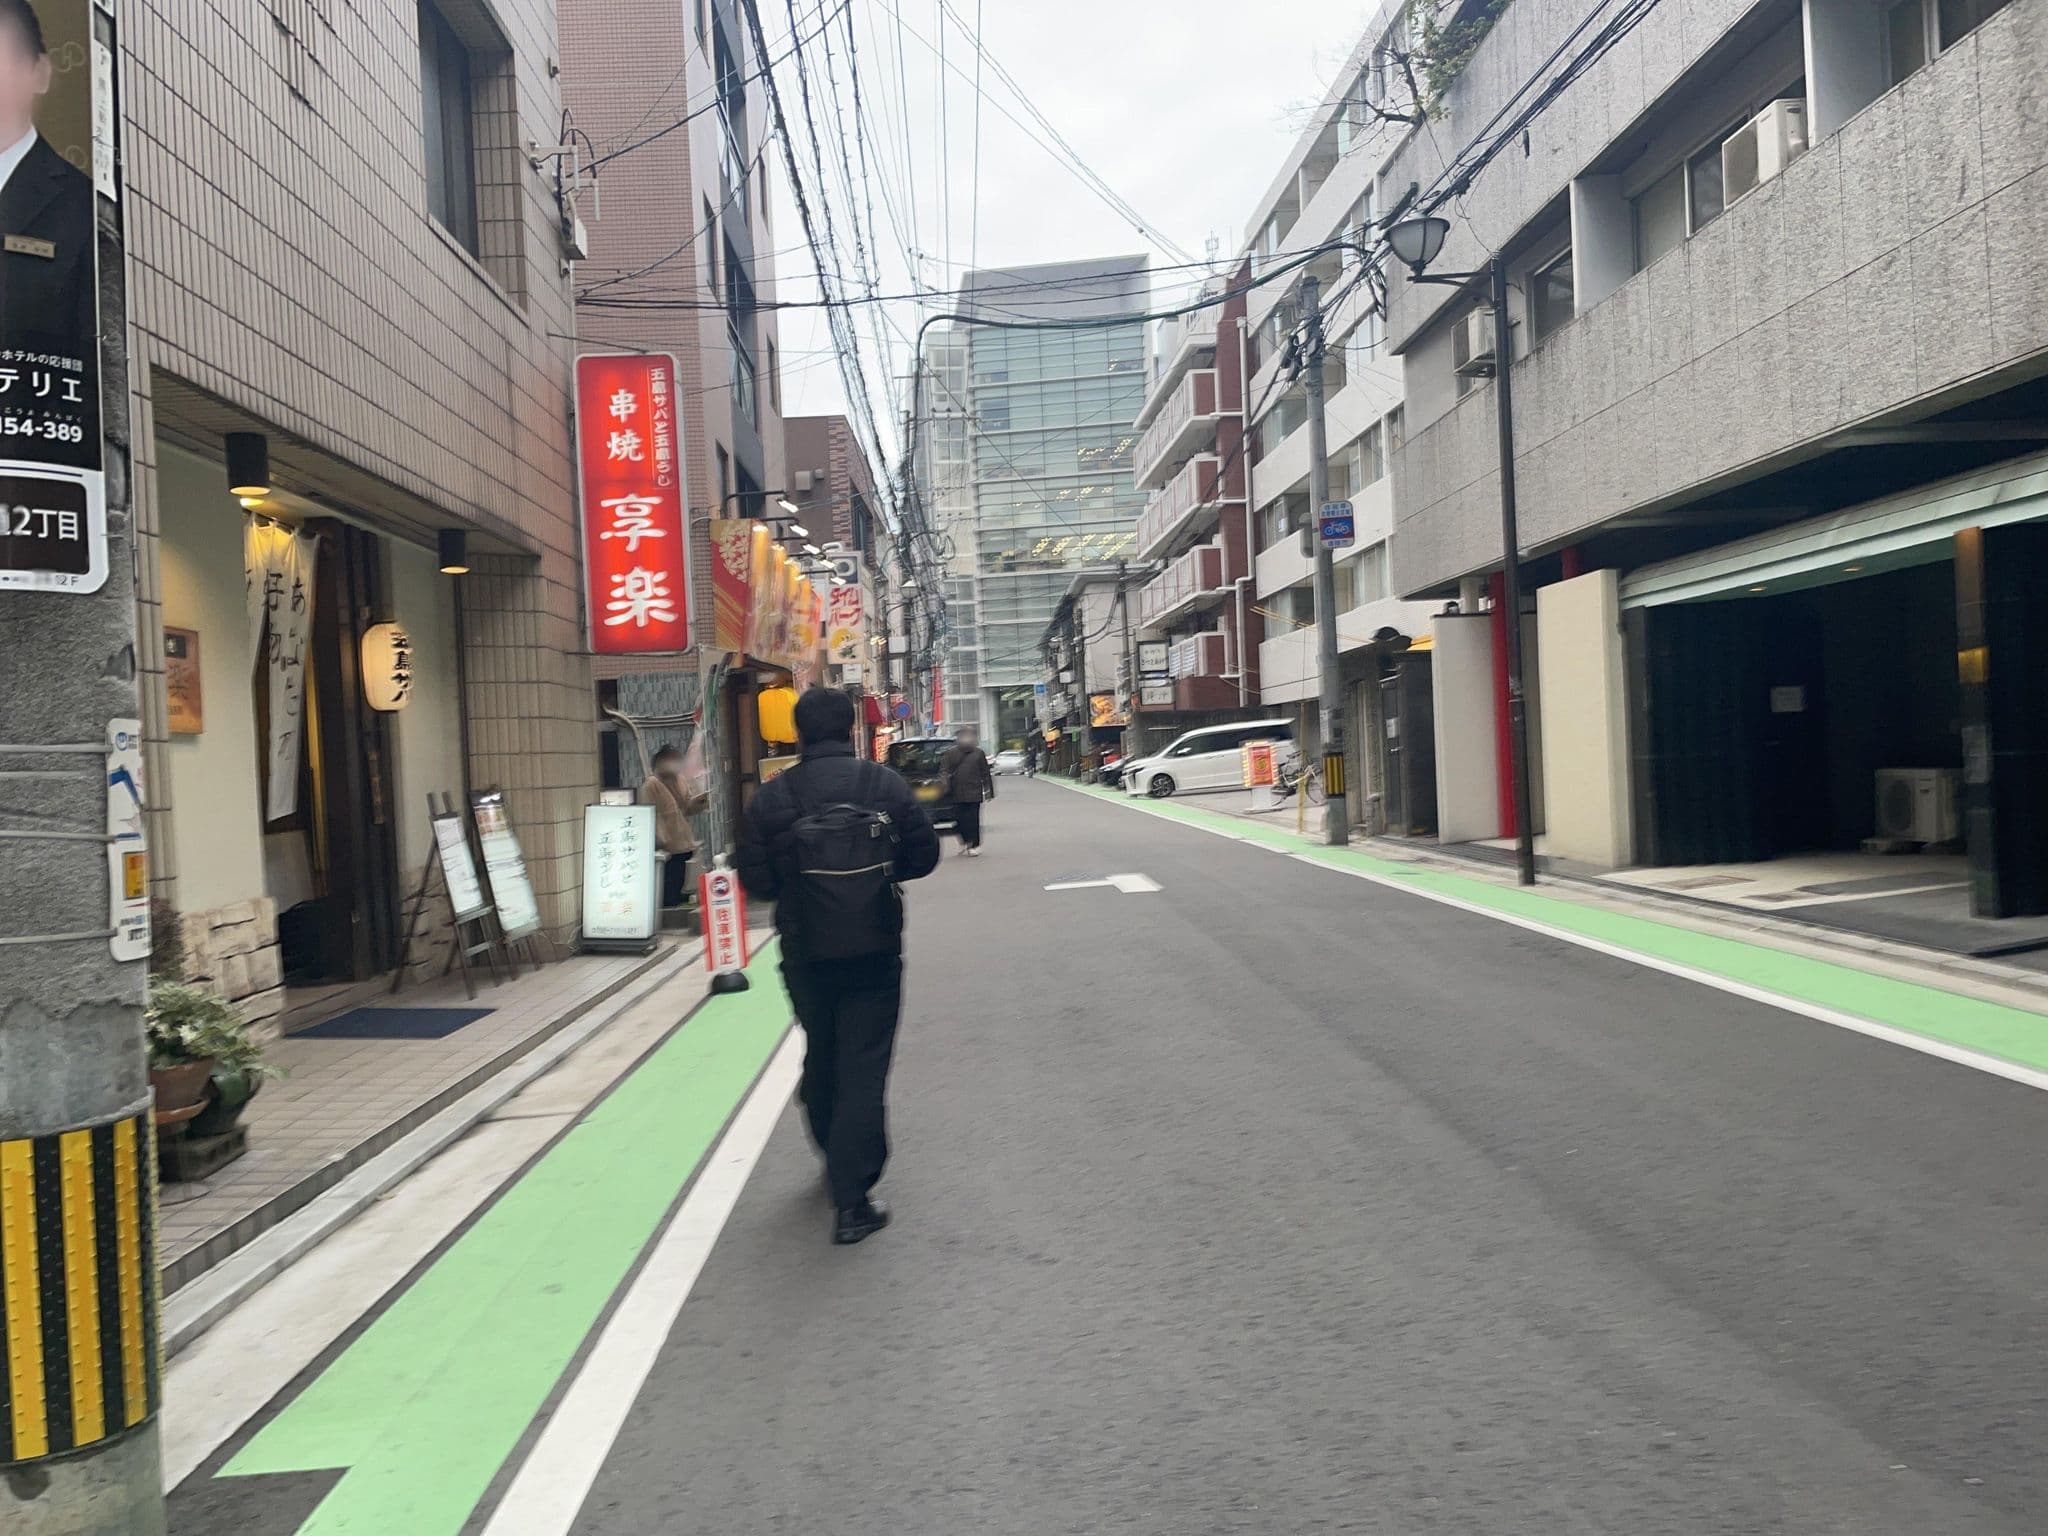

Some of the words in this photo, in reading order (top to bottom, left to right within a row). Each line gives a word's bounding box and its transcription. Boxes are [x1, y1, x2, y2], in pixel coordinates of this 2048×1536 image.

[0, 350, 83, 373] ホテルの応援団
[606, 388, 646, 462] 串焼
[0, 503, 78, 541] 2丁目
[600, 493, 678, 627] 享楽
